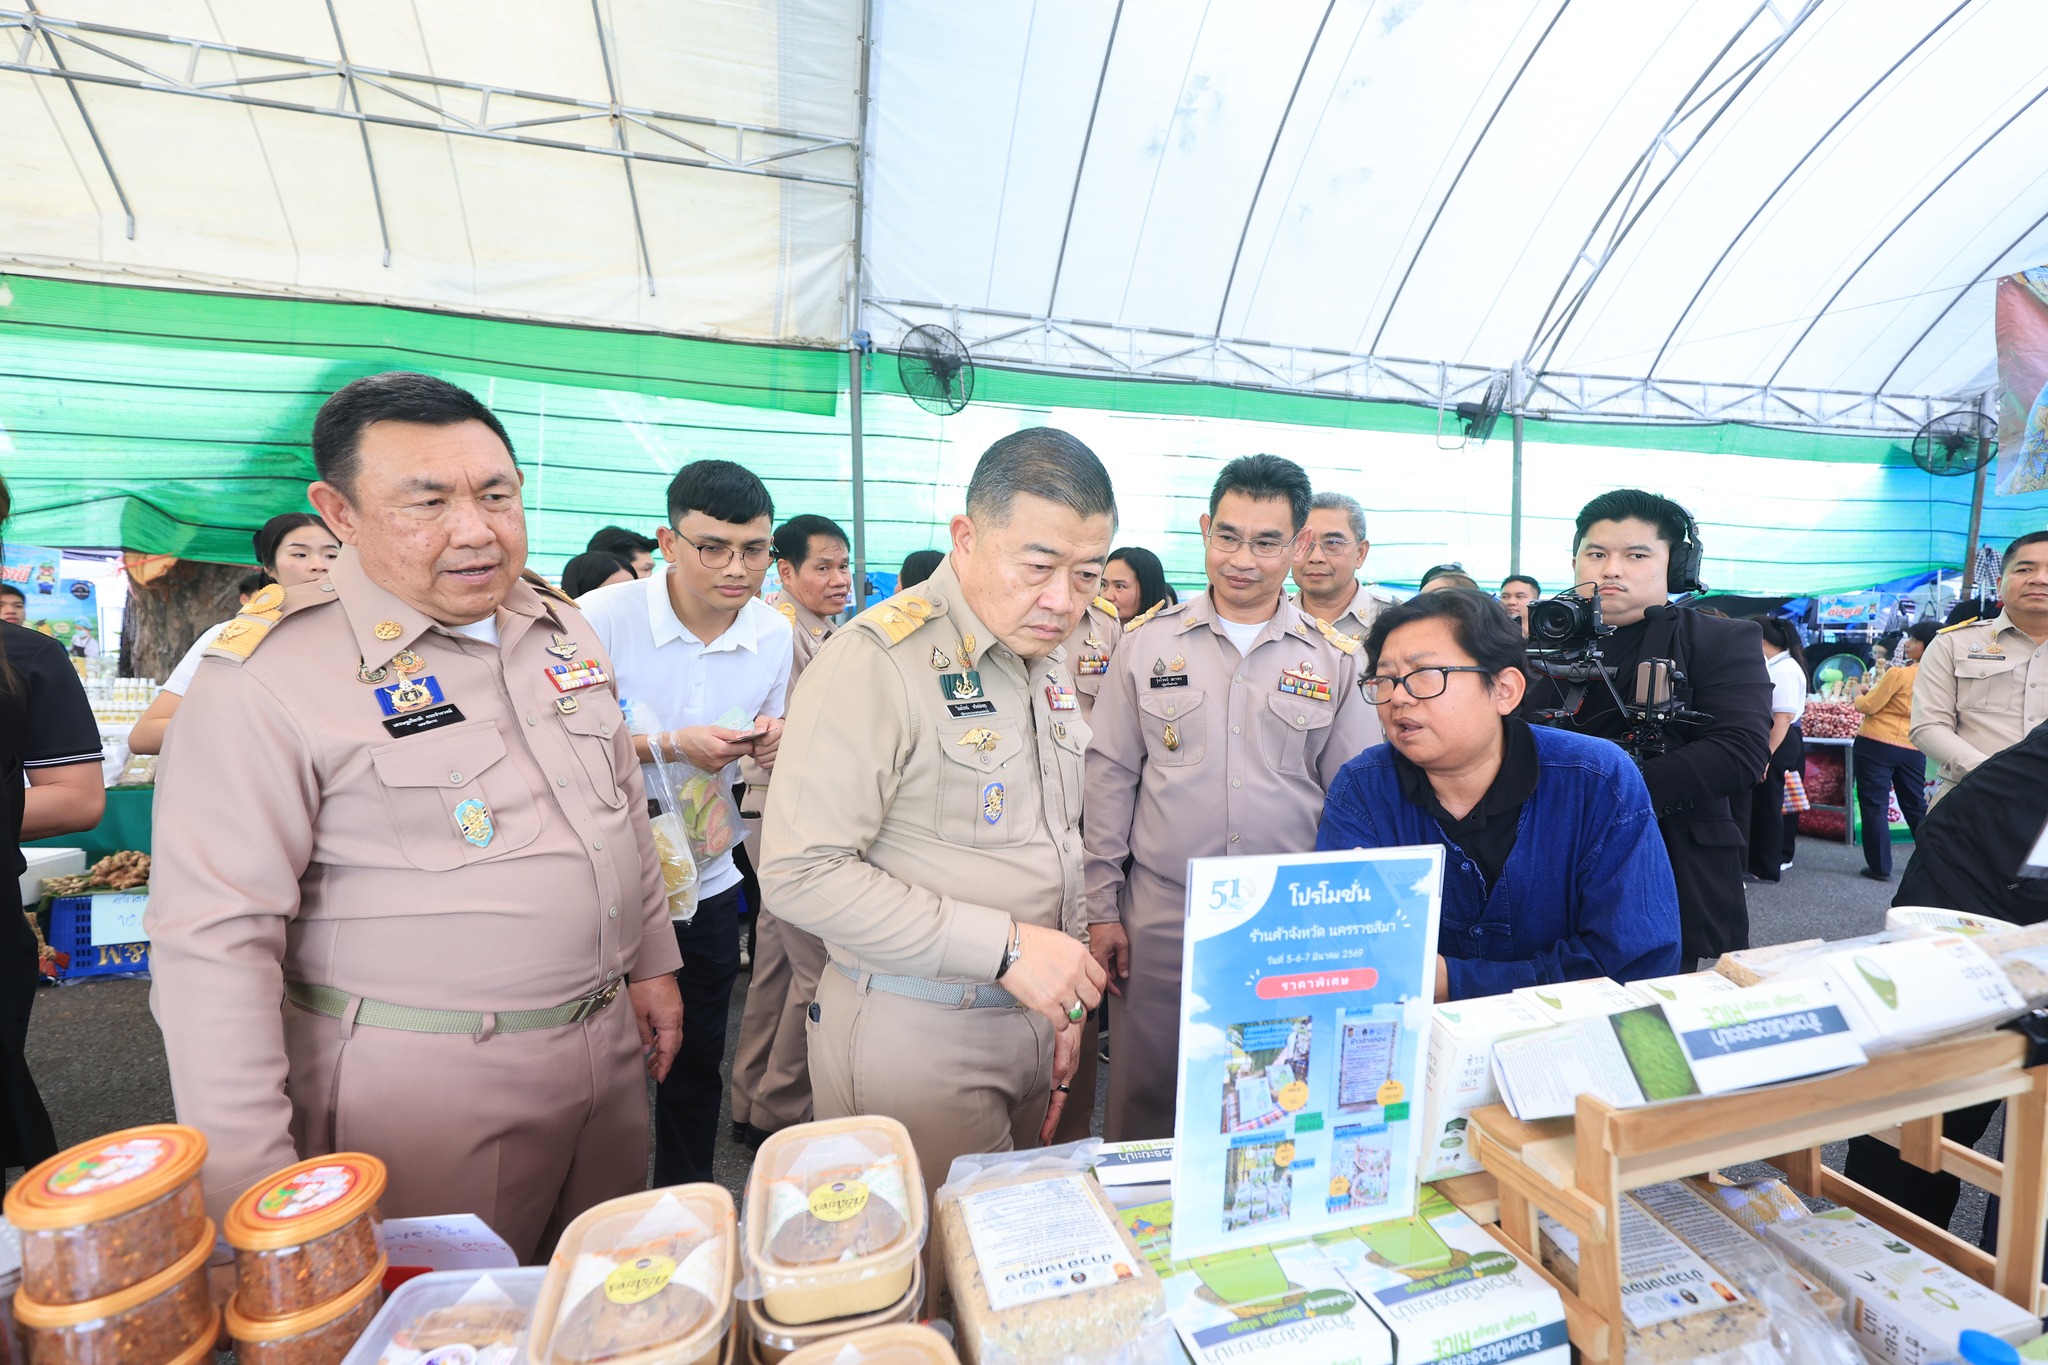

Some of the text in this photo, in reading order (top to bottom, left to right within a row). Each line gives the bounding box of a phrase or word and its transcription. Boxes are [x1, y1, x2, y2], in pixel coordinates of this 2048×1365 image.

[1208, 878, 1241, 910] 51
[1288, 879, 1372, 907] โปรโมชั่น
[1249, 920, 1396, 943] ร้านค้าจังหวัด นครราชสีมา
[97, 943, 152, 966] &M
[1286, 953, 1310, 964] 5-6-7
[1281, 975, 1350, 991] ราคาพิเศษ
